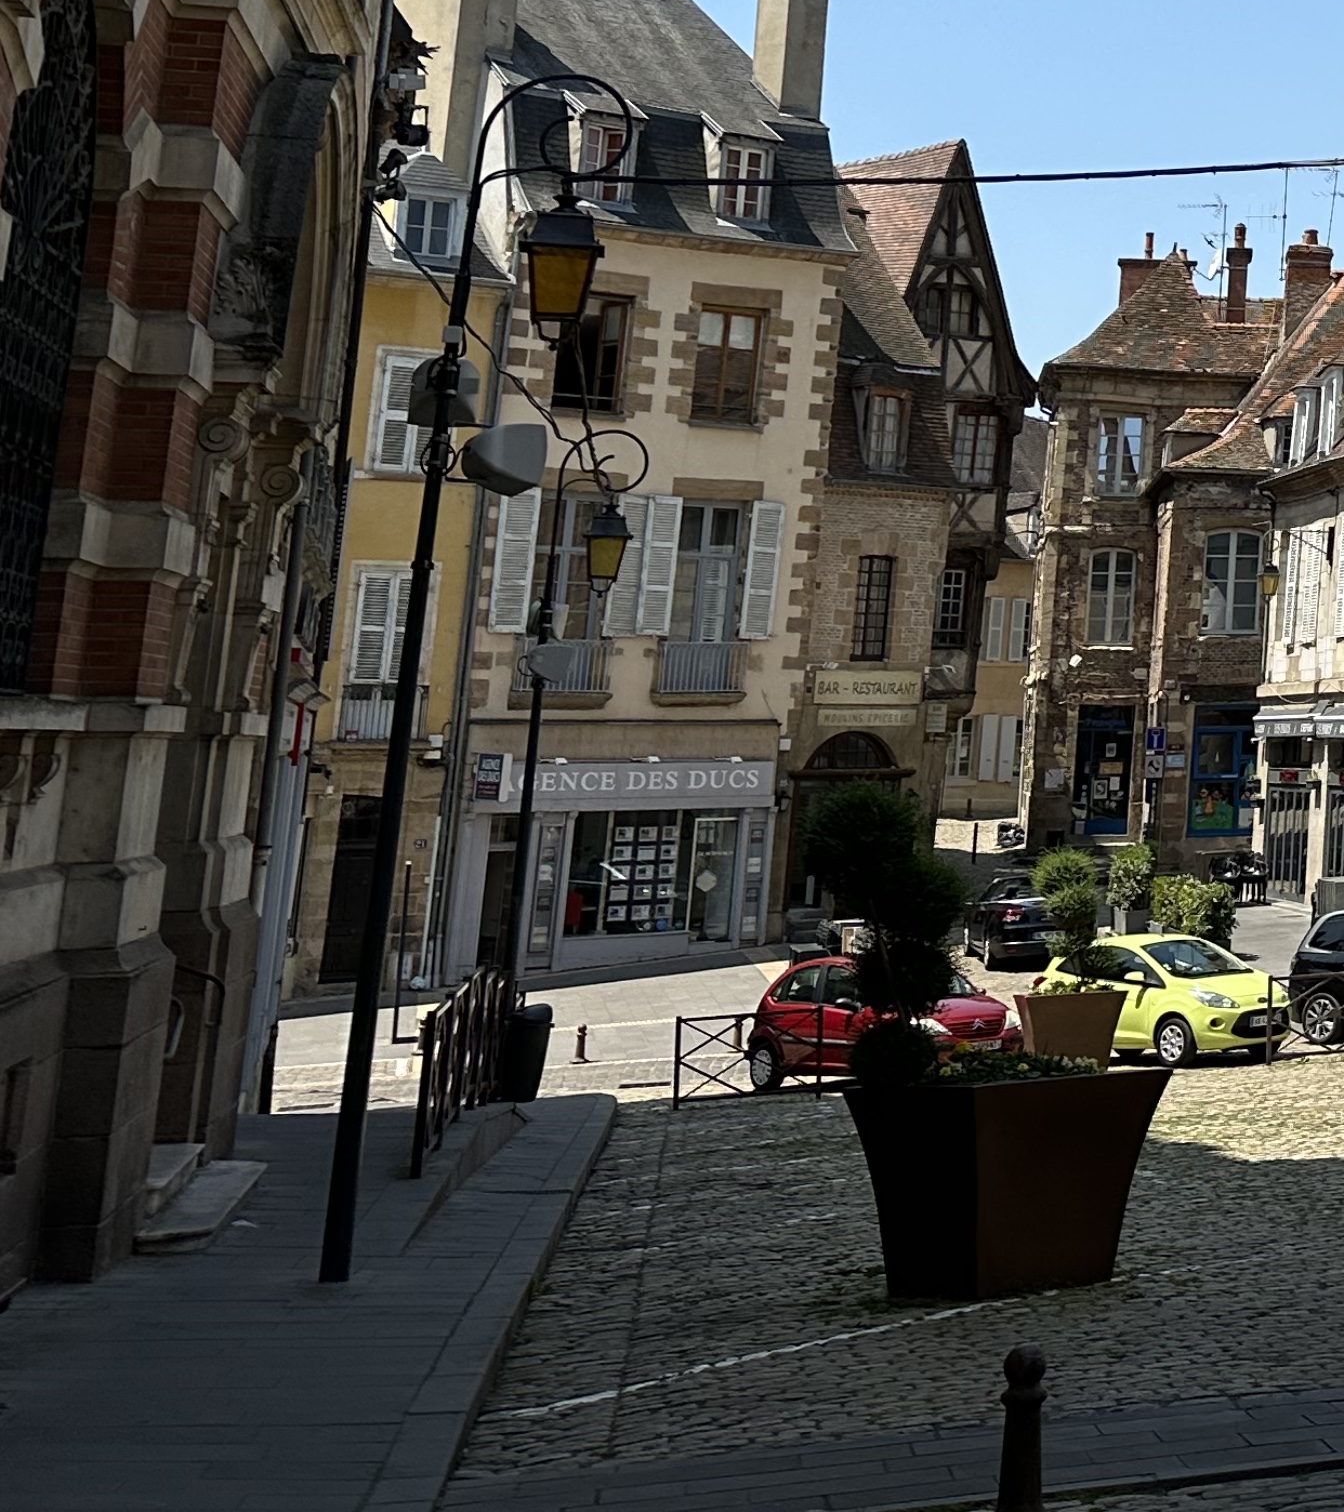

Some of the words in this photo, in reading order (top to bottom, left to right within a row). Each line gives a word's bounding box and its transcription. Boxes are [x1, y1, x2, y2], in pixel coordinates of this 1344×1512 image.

[817, 681, 840, 695] BAR
[852, 681, 918, 696] RESTAURANT
[626, 771, 678, 790] DES
[688, 769, 760, 789] DUCS
